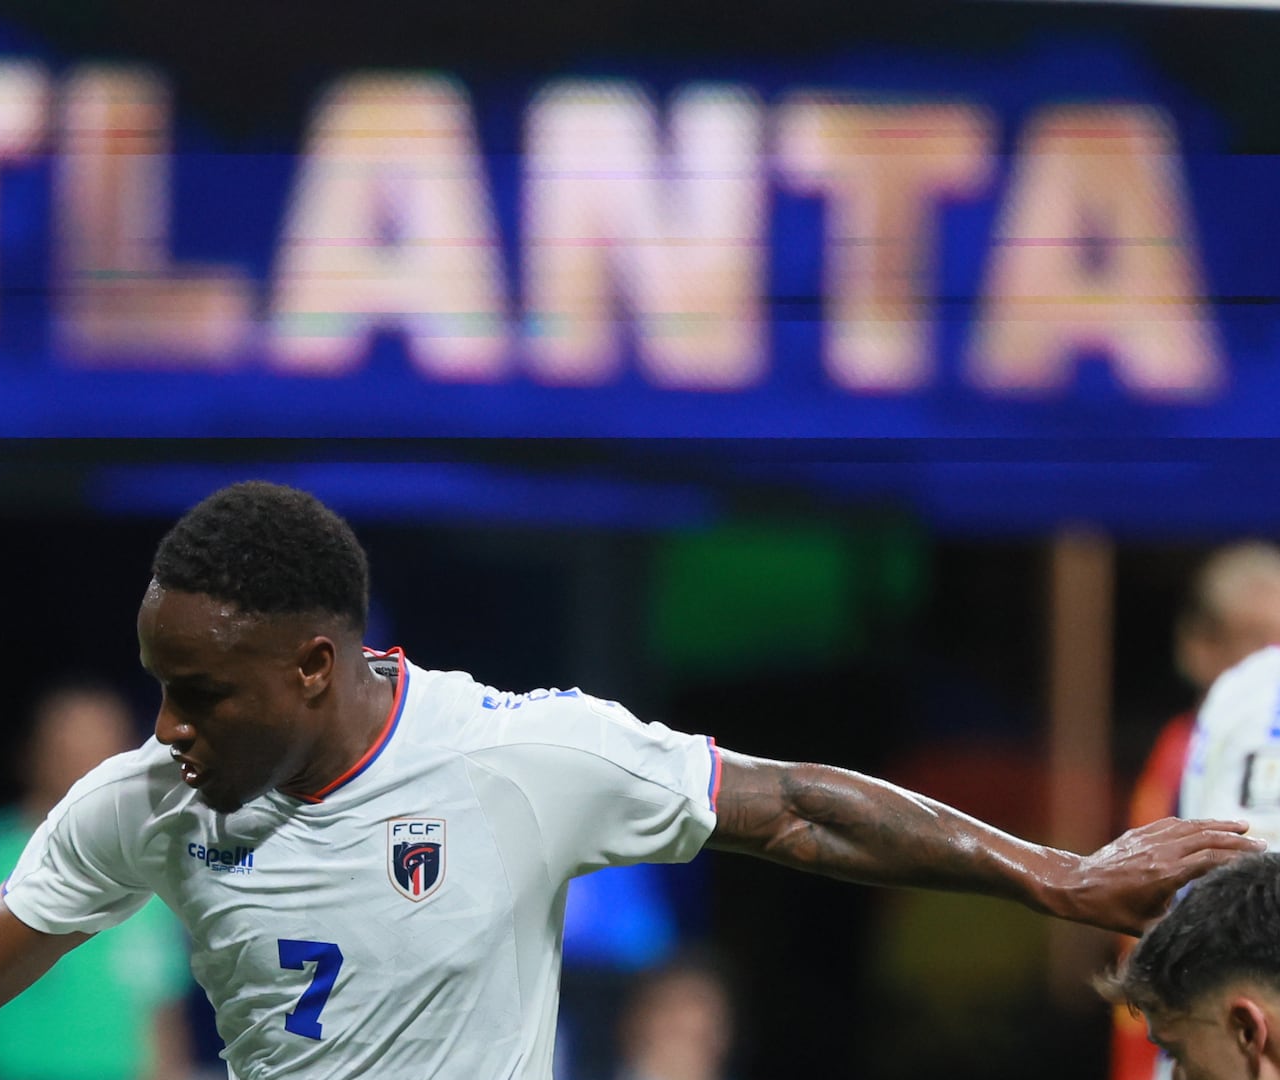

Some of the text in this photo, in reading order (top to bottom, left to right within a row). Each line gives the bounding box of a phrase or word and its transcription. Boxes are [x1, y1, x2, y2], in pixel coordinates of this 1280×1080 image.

[393, 823, 440, 836] FCF
[188, 842, 255, 868] capelli
[211, 863, 253, 875] SPORT
[278, 939, 344, 1041] 7
